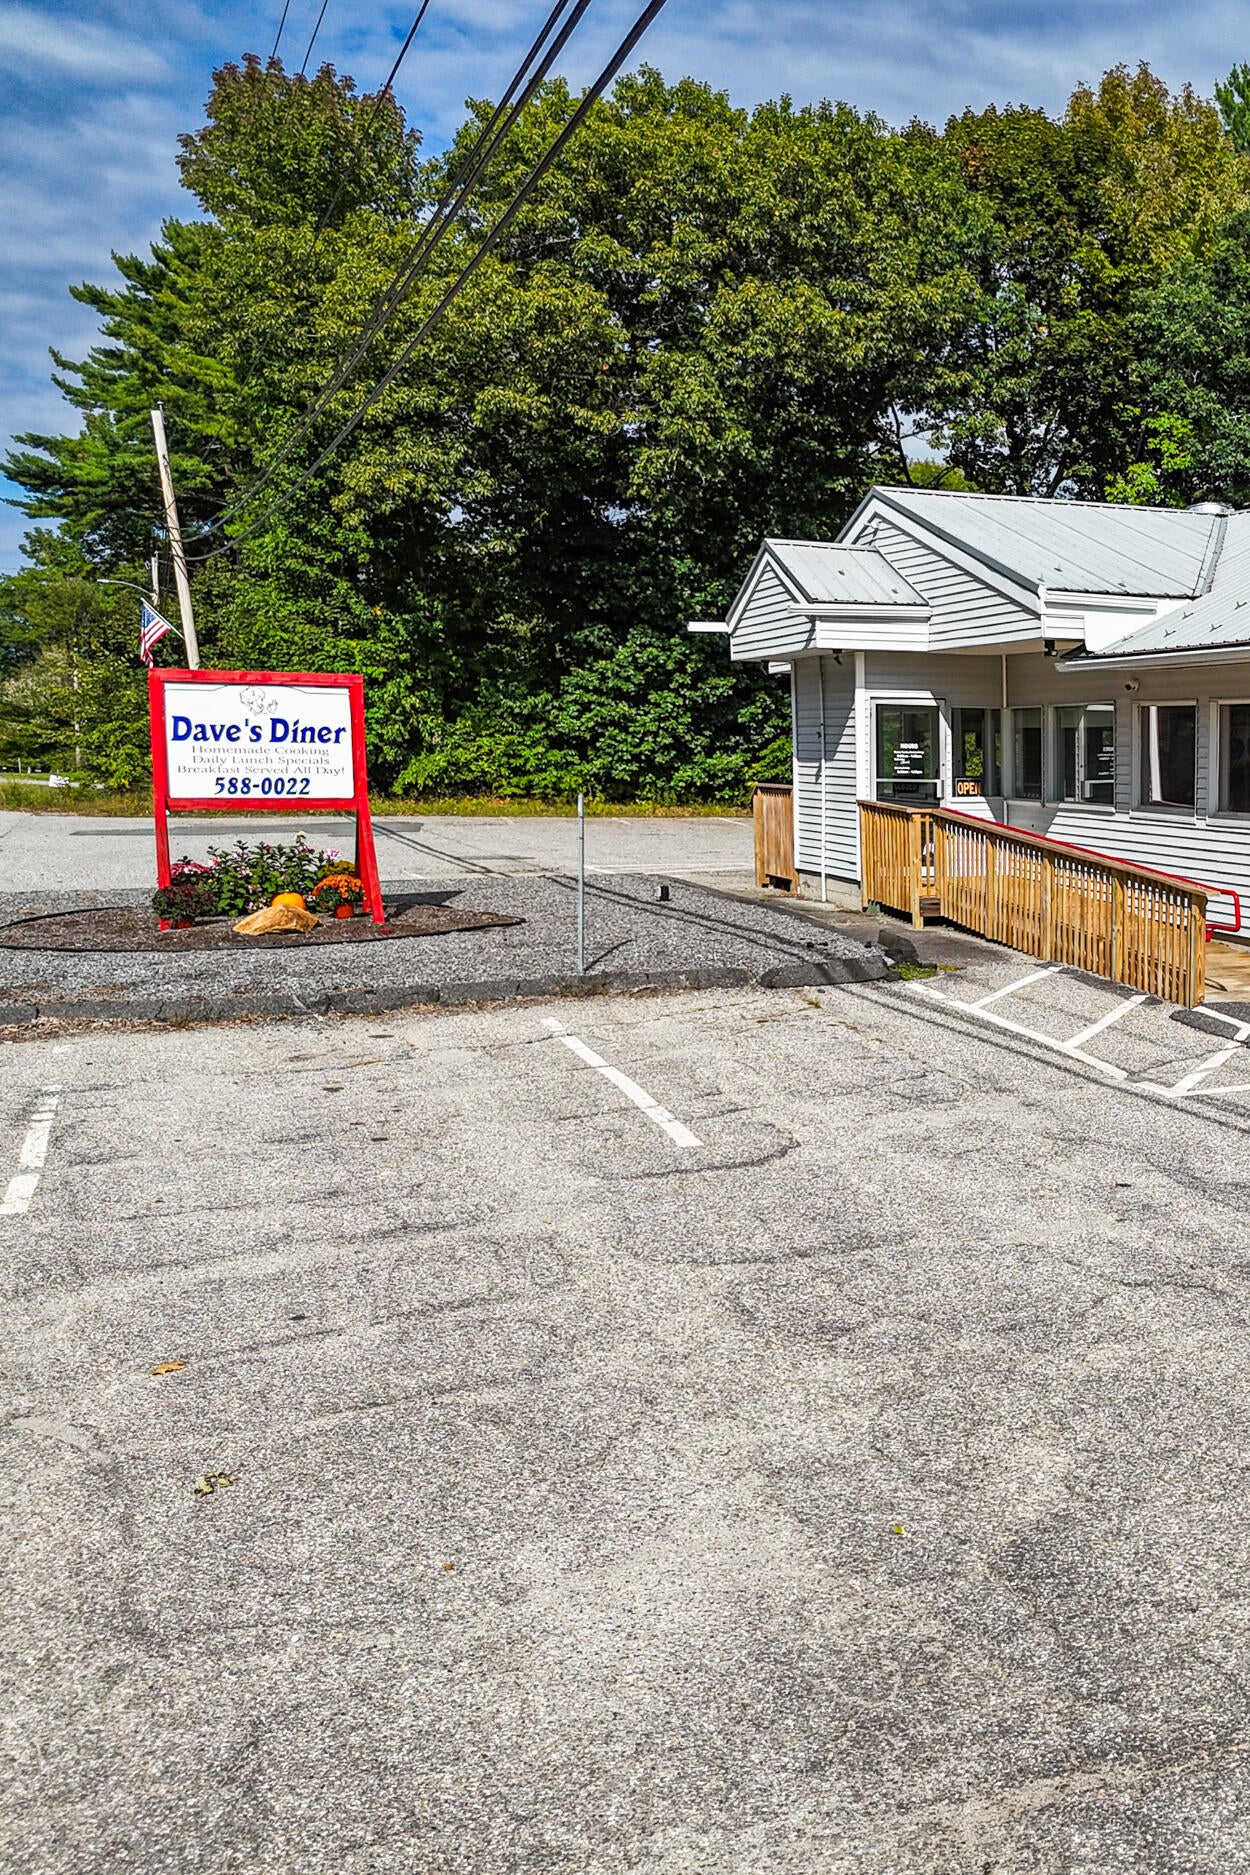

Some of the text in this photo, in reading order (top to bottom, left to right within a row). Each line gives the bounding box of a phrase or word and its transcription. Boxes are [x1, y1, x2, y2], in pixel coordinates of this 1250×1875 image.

[171, 715, 347, 744] Dave's Diner
[191, 745, 330, 756] Homemade Cooking
[192, 755, 330, 766] Daily Lunch Specials
[177, 765, 346, 777] Breakfast Served All Day!
[214, 777, 312, 795] 588-0022
[957, 781, 981, 795] OPEN
